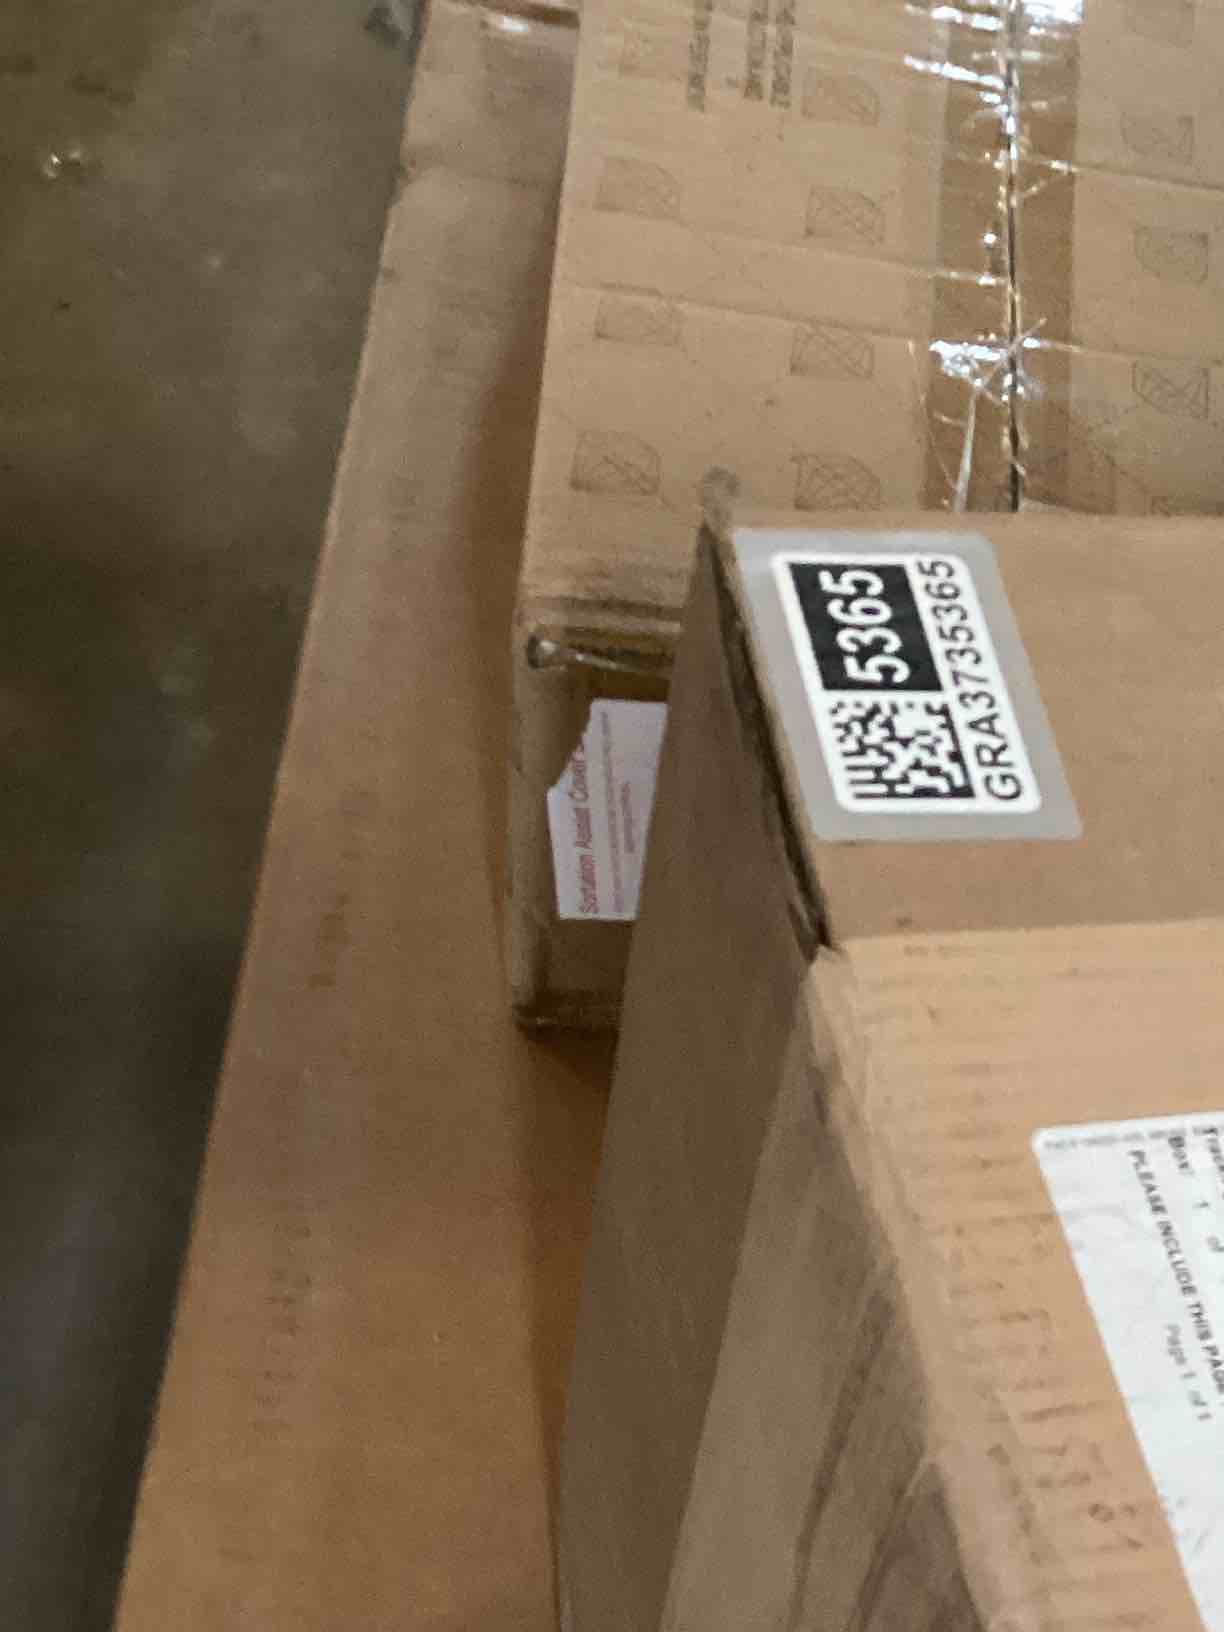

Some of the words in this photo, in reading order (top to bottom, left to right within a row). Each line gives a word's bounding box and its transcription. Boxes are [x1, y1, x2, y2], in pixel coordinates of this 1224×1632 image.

[817, 568, 910, 685] 5365
[917, 560, 1023, 801] GRA3735365
[1129, 1149, 1168, 1216] PLEASE
[1156, 1220, 1198, 1297] INCLUDE
[1187, 1301, 1213, 1342] THIS
